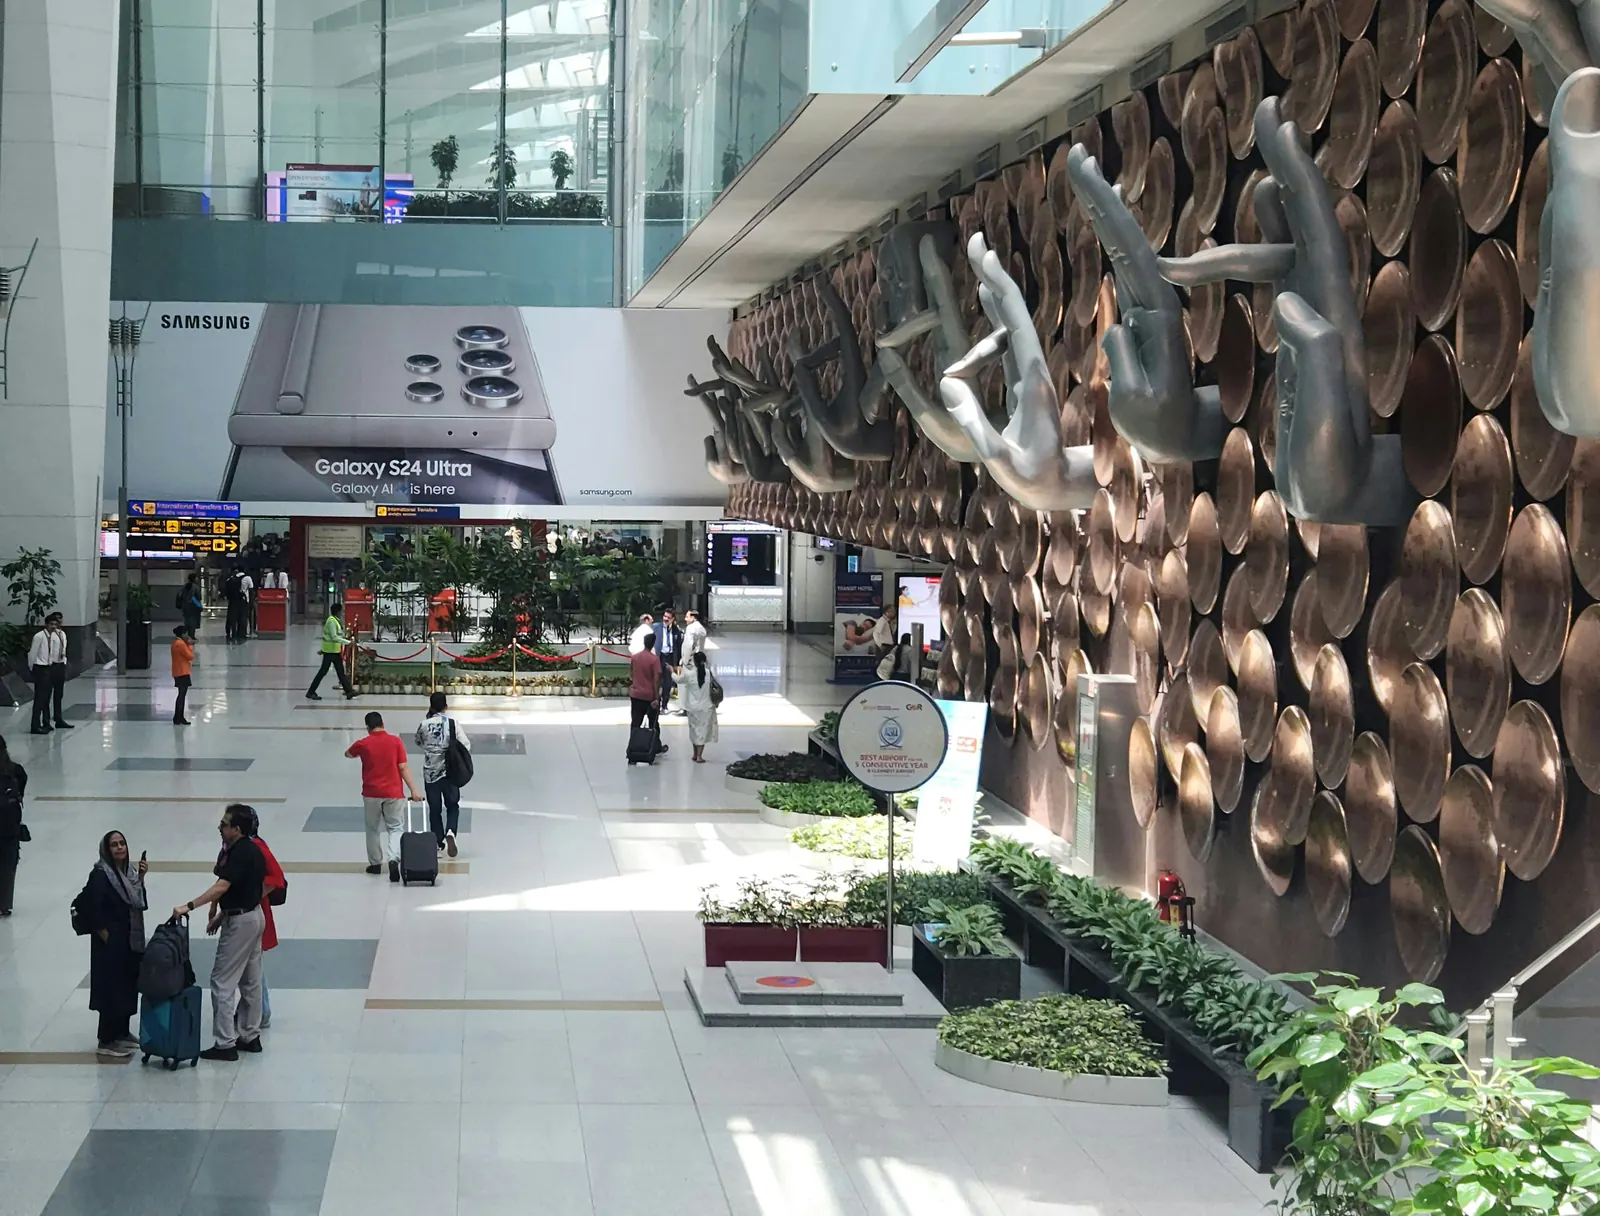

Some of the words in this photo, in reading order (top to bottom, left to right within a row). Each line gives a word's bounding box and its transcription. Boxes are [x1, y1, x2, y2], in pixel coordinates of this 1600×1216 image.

[161, 314, 250, 330] SAMSUNG
[315, 459, 386, 479] Galaxy
[389, 459, 422, 476] S24
[426, 460, 472, 477] Ultra
[331, 482, 379, 497] Galaxy
[381, 483, 394, 495] AI
[410, 483, 421, 495] is
[424, 483, 456, 496] here
[580, 489, 633, 498] samsung.com
[157, 502, 194, 510] International
